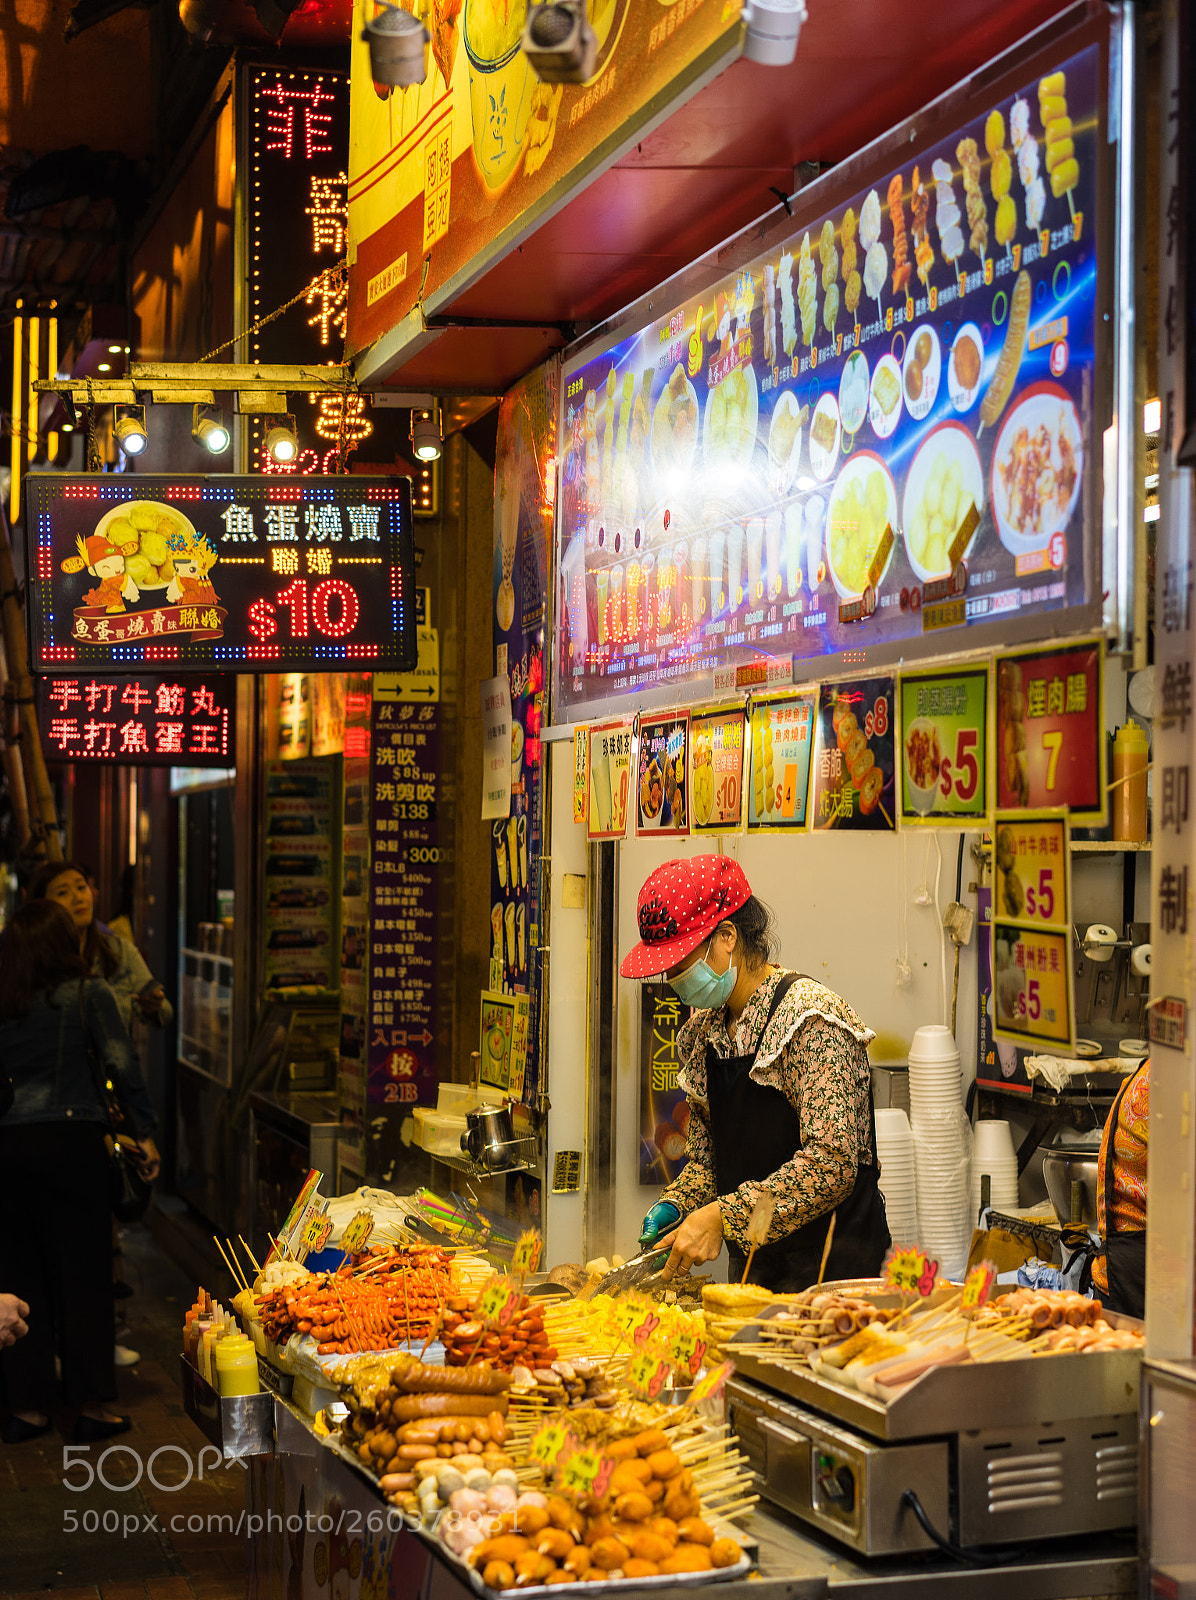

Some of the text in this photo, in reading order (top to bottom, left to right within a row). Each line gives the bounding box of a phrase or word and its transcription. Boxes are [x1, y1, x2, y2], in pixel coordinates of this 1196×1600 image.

[220, 503, 382, 543] 魚蛋燒賣
[271, 547, 333, 575] 聯婚
[73, 607, 222, 642] 魚蛋哥燒賣妹聯婚
[247, 579, 360, 641] $10
[49, 679, 221, 717] 手打牛筋丸
[865, 696, 888, 739] $8
[48, 717, 220, 754] 手打魚蛋王
[376, 747, 416, 766] 洗吹
[940, 727, 979, 802] $5
[1042, 730, 1064, 791] 7
[376, 783, 436, 801] 洗剪吹
[716, 775, 737, 810] $10
[818, 787, 854, 818] 炸大腸
[392, 803, 429, 819] $138
[1026, 867, 1055, 920] $5
[1018, 978, 1042, 1021] $5
[371, 1029, 408, 1046] 入口
[390, 1053, 414, 1076] 按
[384, 1082, 418, 1103] 2B
